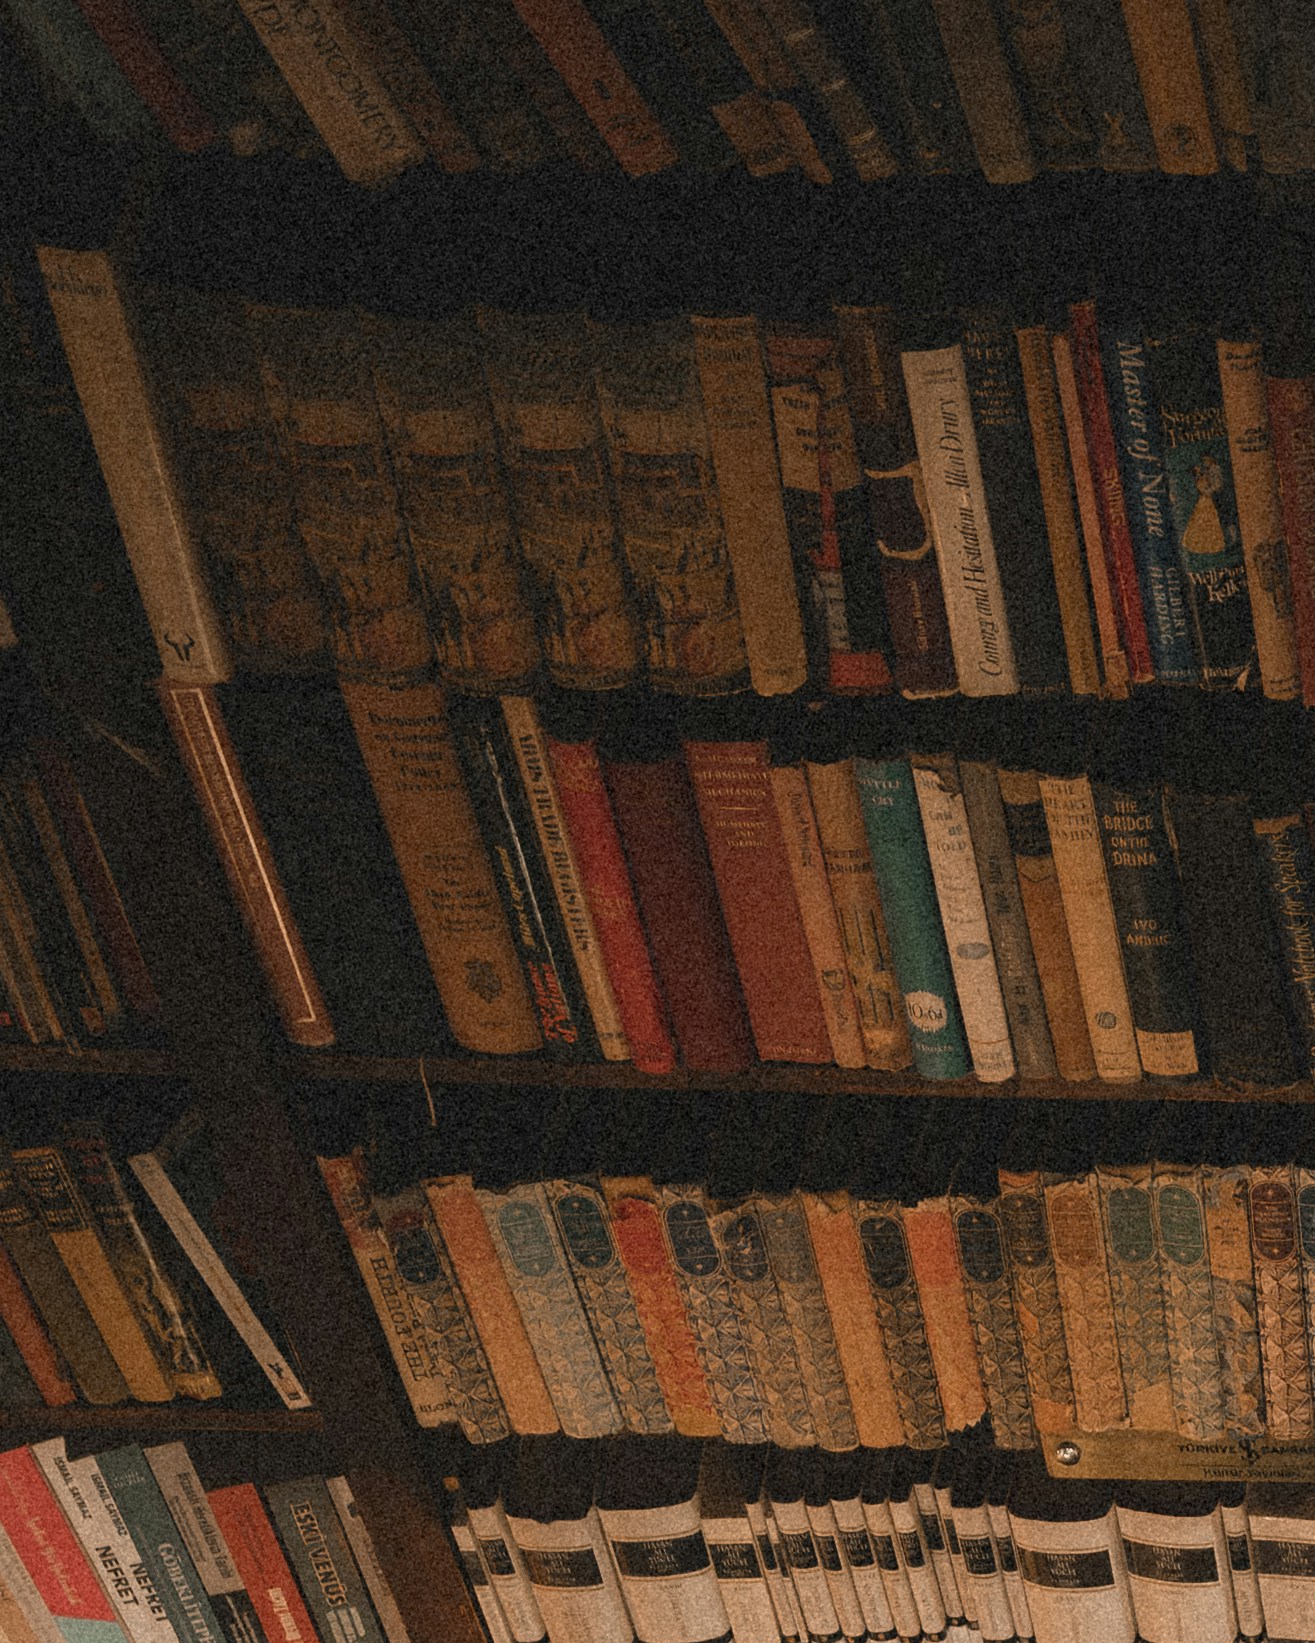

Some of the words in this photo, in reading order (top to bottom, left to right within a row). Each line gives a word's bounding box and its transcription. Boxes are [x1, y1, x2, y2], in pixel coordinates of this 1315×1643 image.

[1115, 338, 1155, 433] Master
[1124, 436, 1157, 465] of
[1136, 471, 1170, 539] None
[1102, 813, 1153, 833] BRIDGE
[1112, 799, 1139, 815] THE
[1111, 850, 1159, 869] DRINA
[1131, 917, 1158, 934] IVO
[288, 1497, 326, 1549] ESKİ
[94, 1539, 140, 1612] NEFRET
[126, 1556, 171, 1627] NEFRET
[305, 1542, 353, 1611] VENÜS
